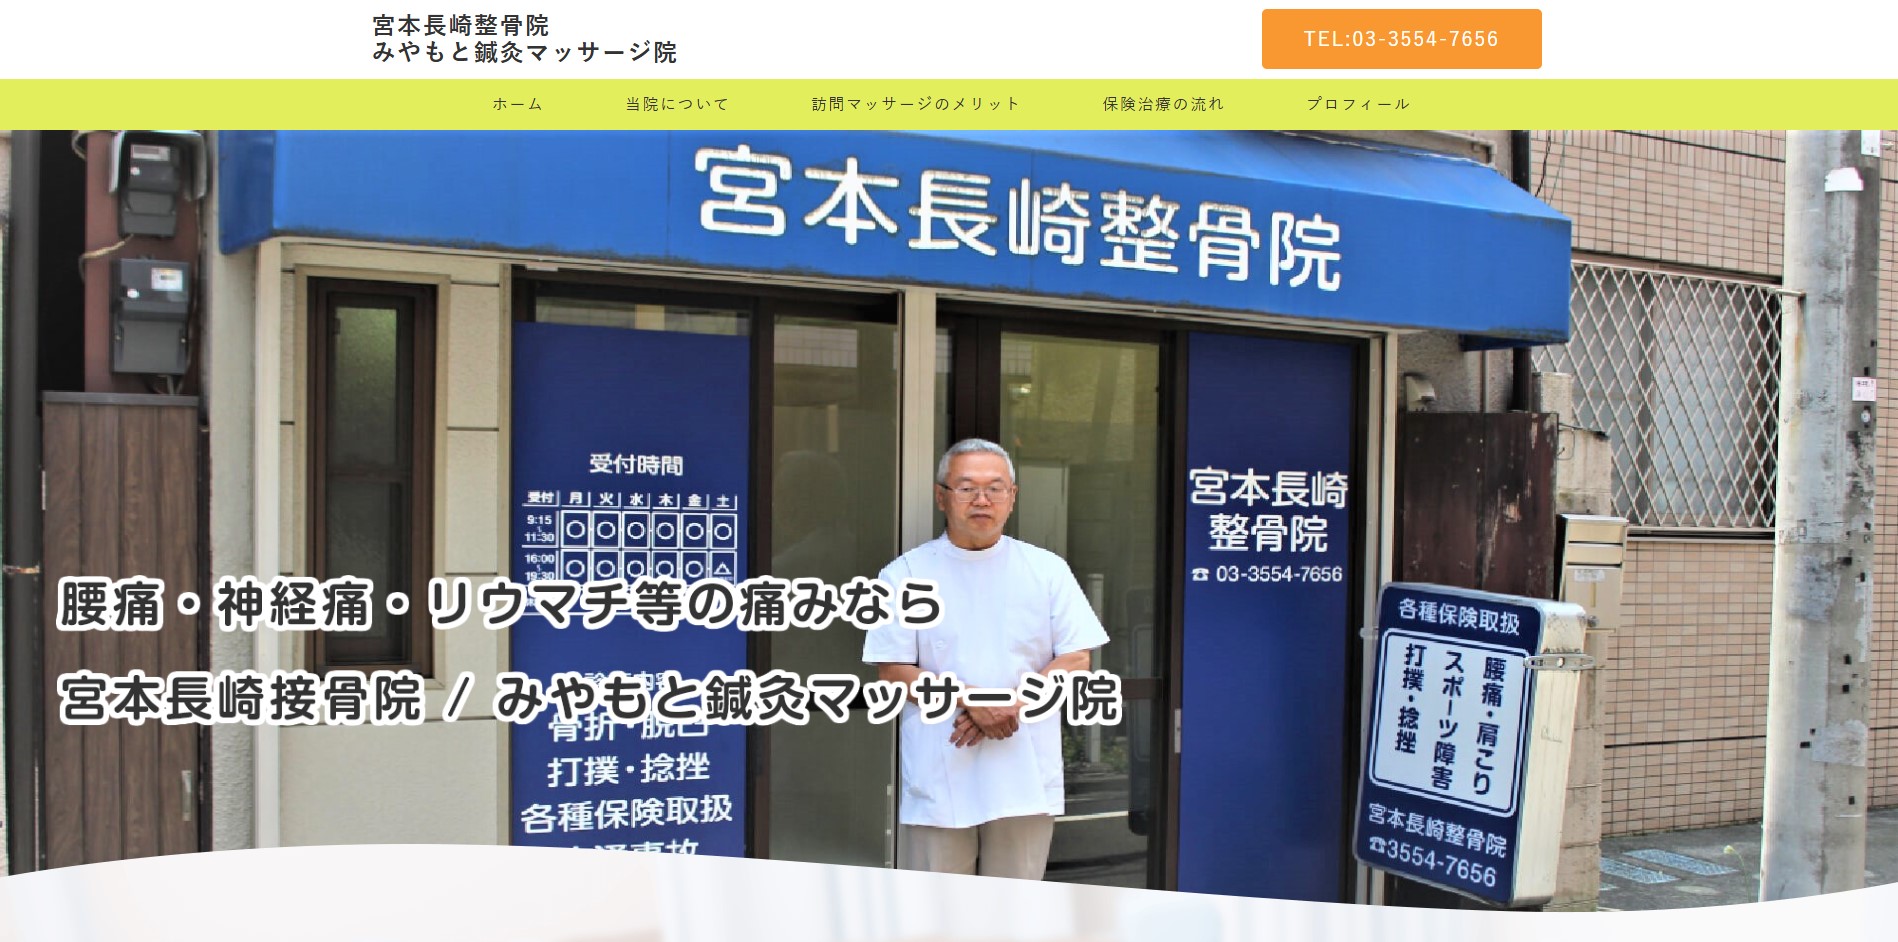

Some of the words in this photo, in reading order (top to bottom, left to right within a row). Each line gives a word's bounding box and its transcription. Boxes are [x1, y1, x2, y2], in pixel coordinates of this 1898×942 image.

[694, 144, 1342, 292] 宮本長崎整骨院
[589, 452, 684, 477] 受付時間
[527, 490, 555, 504] 受付
[569, 491, 583, 504] 月
[599, 492, 614, 506] 火
[629, 492, 644, 506] 水
[658, 493, 674, 507] 木
[687, 494, 702, 507] 金
[716, 494, 730, 508] 土
[1189, 465, 1349, 509] 宮本長崎
[524, 532, 555, 542] 11:30
[526, 514, 552, 525] 9:15
[1208, 512, 1328, 553] 整骨院
[524, 553, 555, 564] 16:00
[1215, 565, 1344, 583] 03-3554-7656
[1399, 598, 1520, 636] 各種保険取扱
[1394, 642, 1428, 755] 打撲・捻挫
[1430, 650, 1465, 791] スポーツ障害
[1472, 656, 1507, 796] 腰痛・肩こり
[547, 751, 711, 788] 打撲・捻挫
[520, 794, 733, 834] 各種保険取扱
[1368, 802, 1507, 859] 宮本長崎整骨院
